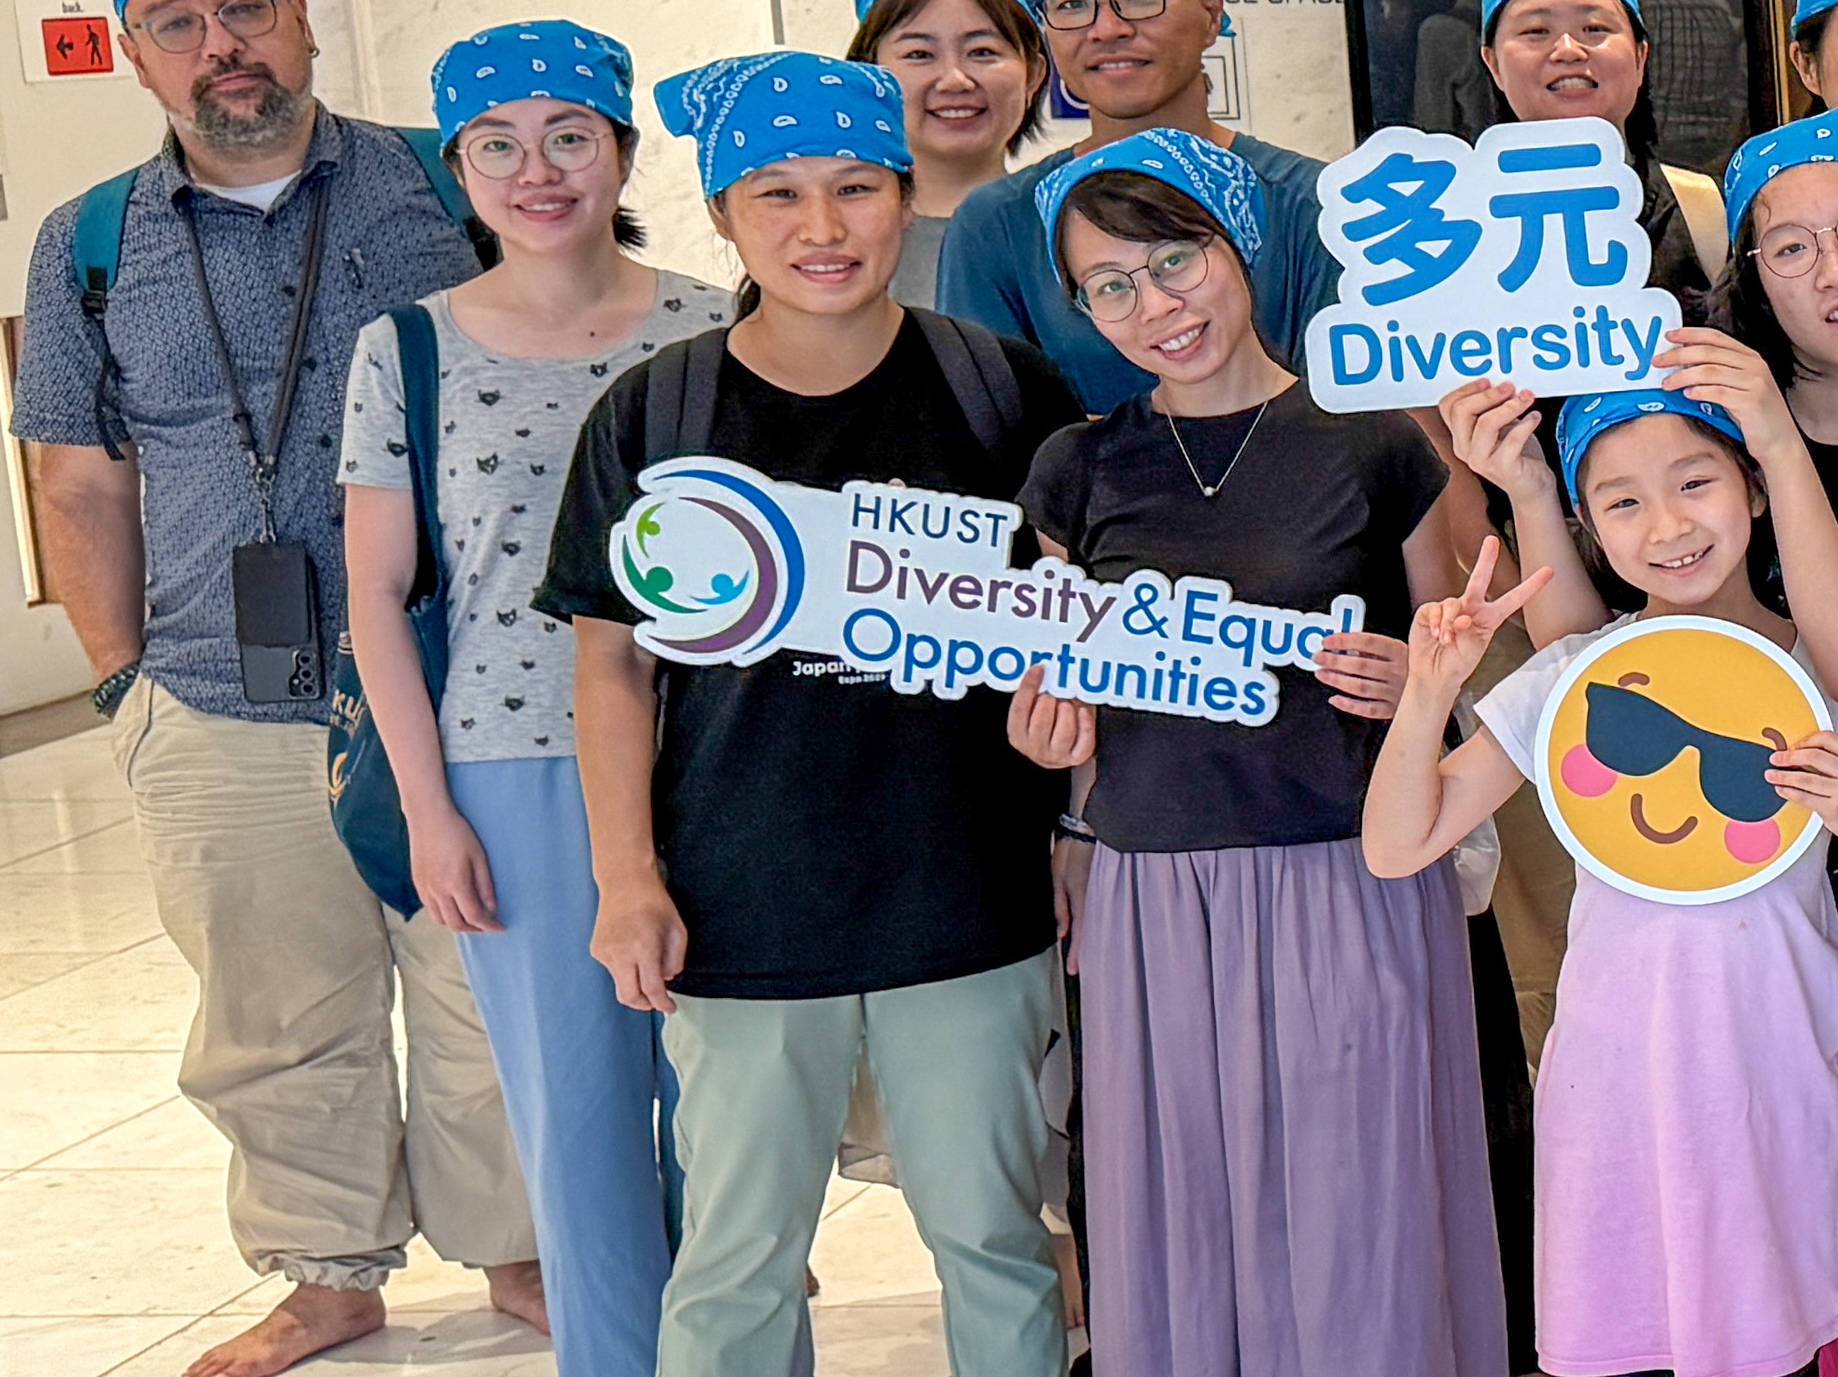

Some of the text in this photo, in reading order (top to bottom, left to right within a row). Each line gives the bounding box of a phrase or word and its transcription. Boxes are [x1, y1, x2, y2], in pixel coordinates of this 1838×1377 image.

[1340, 143, 1628, 306] 多元
[1329, 305, 1663, 385] Diversity
[850, 494, 1009, 548] HKUST
[846, 540, 1117, 643] Diversity
[1122, 582, 1171, 639] &
[843, 608, 1267, 718] Opportunities
